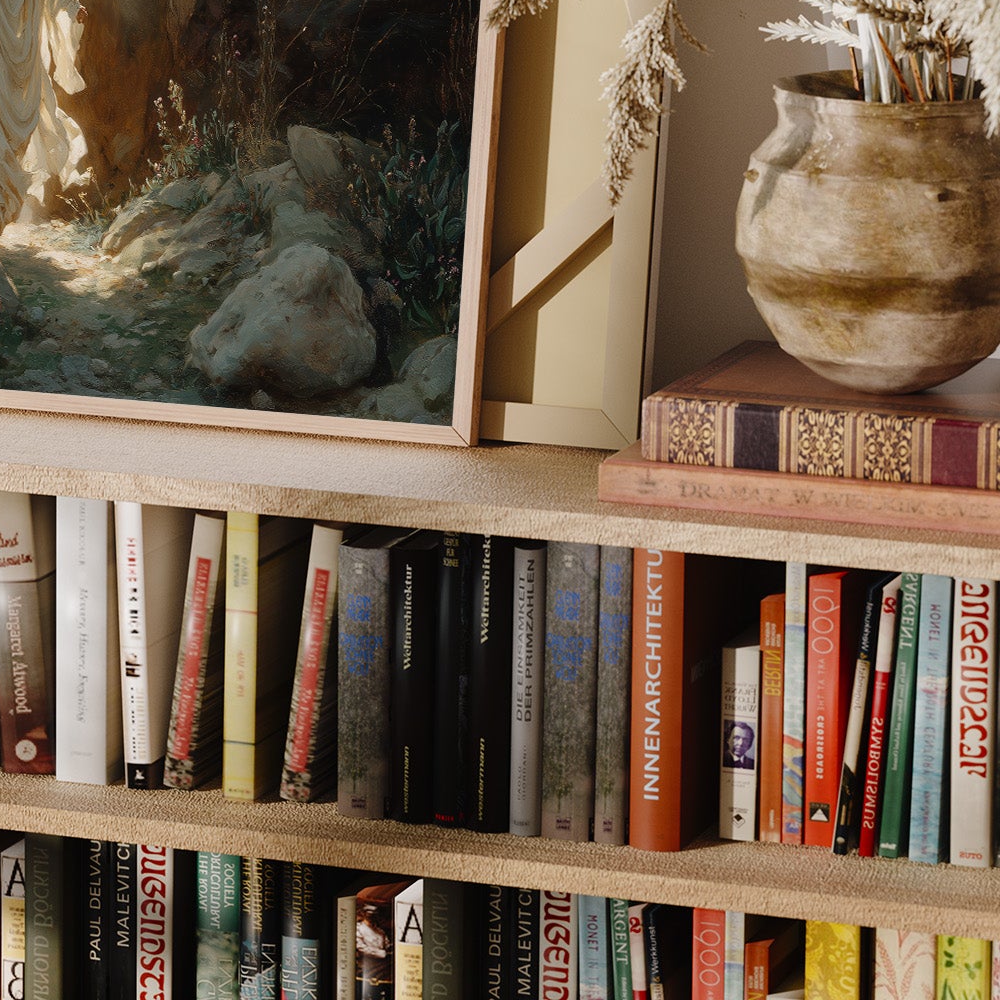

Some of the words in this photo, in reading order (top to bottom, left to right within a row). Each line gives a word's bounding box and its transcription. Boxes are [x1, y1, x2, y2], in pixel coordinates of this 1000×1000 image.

[6, 595, 23, 657] Margaret
[403, 564, 413, 670] Weltarchitektur
[516, 573, 525, 686] EINSAMKEIT
[525, 559, 535, 679] PRIMZAHLEN
[12, 661, 32, 715] Atwood
[524, 683, 533, 722] DER
[643, 549, 663, 801] INNENARCHITEKTU
[478, 737, 486, 821] westermann
[89, 840, 101, 910] DELVAU
[89, 916, 101, 961] PAUL
[488, 885, 503, 957] DELVAU
[587, 914, 599, 952] MONET
[612, 899, 629, 966] ARGENT
[647, 925, 660, 974] Werkkunst
[693, 920, 721, 986] 1900
